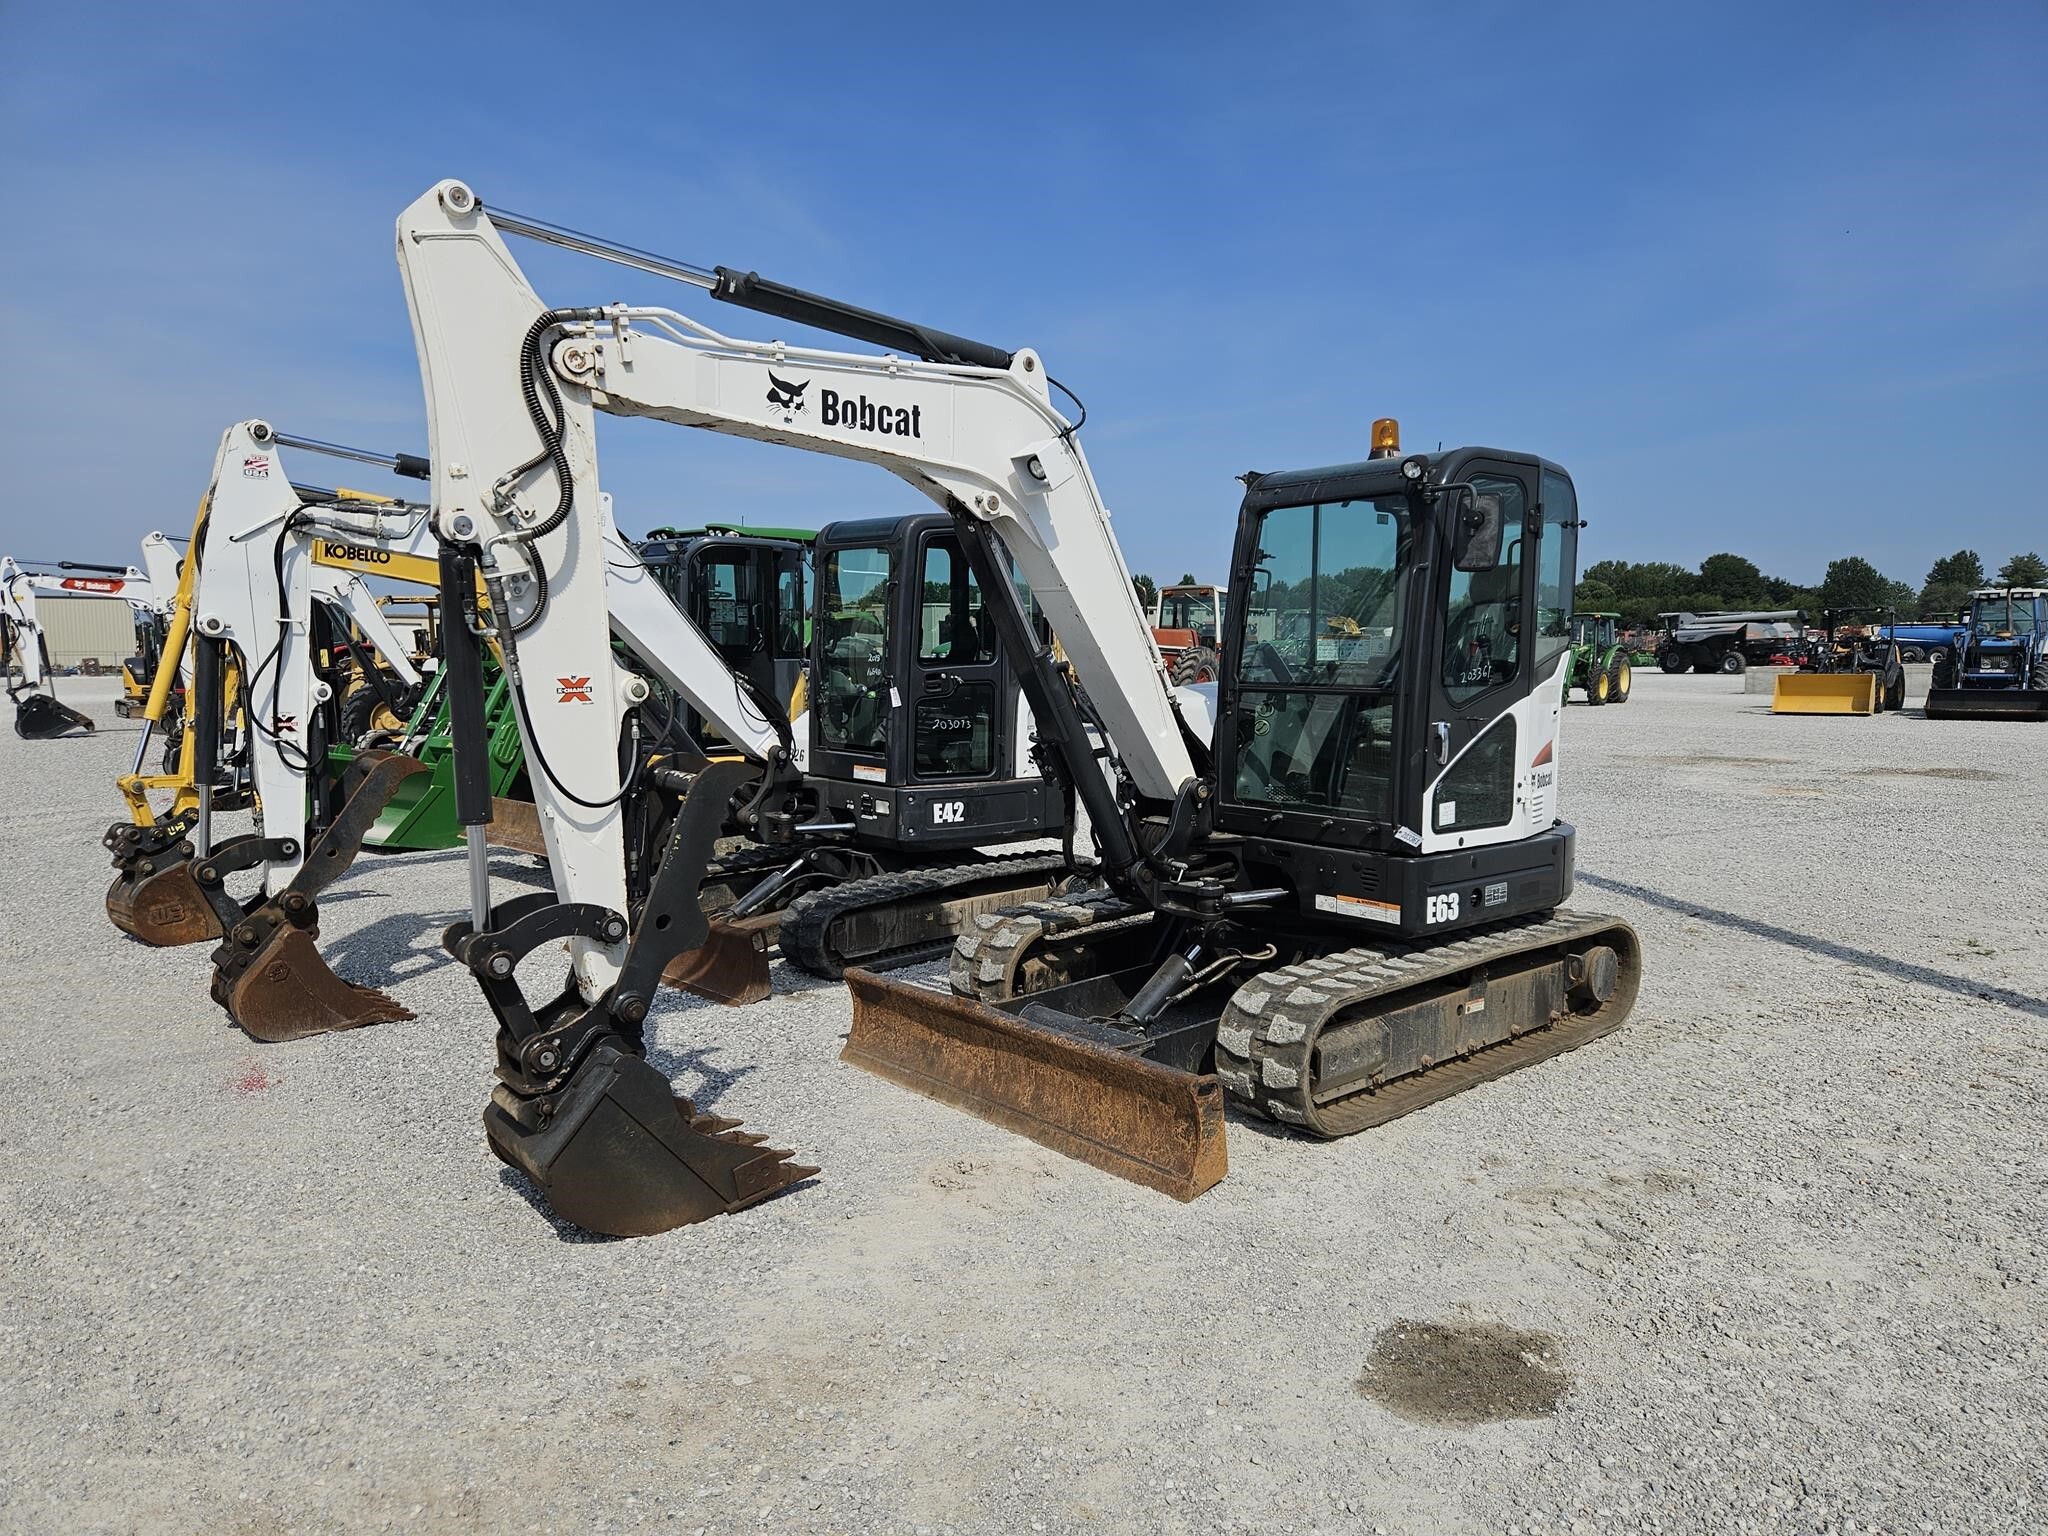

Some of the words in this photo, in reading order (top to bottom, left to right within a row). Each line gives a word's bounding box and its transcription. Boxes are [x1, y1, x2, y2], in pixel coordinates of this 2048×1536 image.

[821, 388, 921, 438] Bobcat
[244, 469, 269, 477] USA
[324, 543, 391, 564] KOBELCO
[1536, 770, 1553, 789] Bobcat
[933, 801, 965, 824] E42
[1426, 892, 1460, 925] E63
